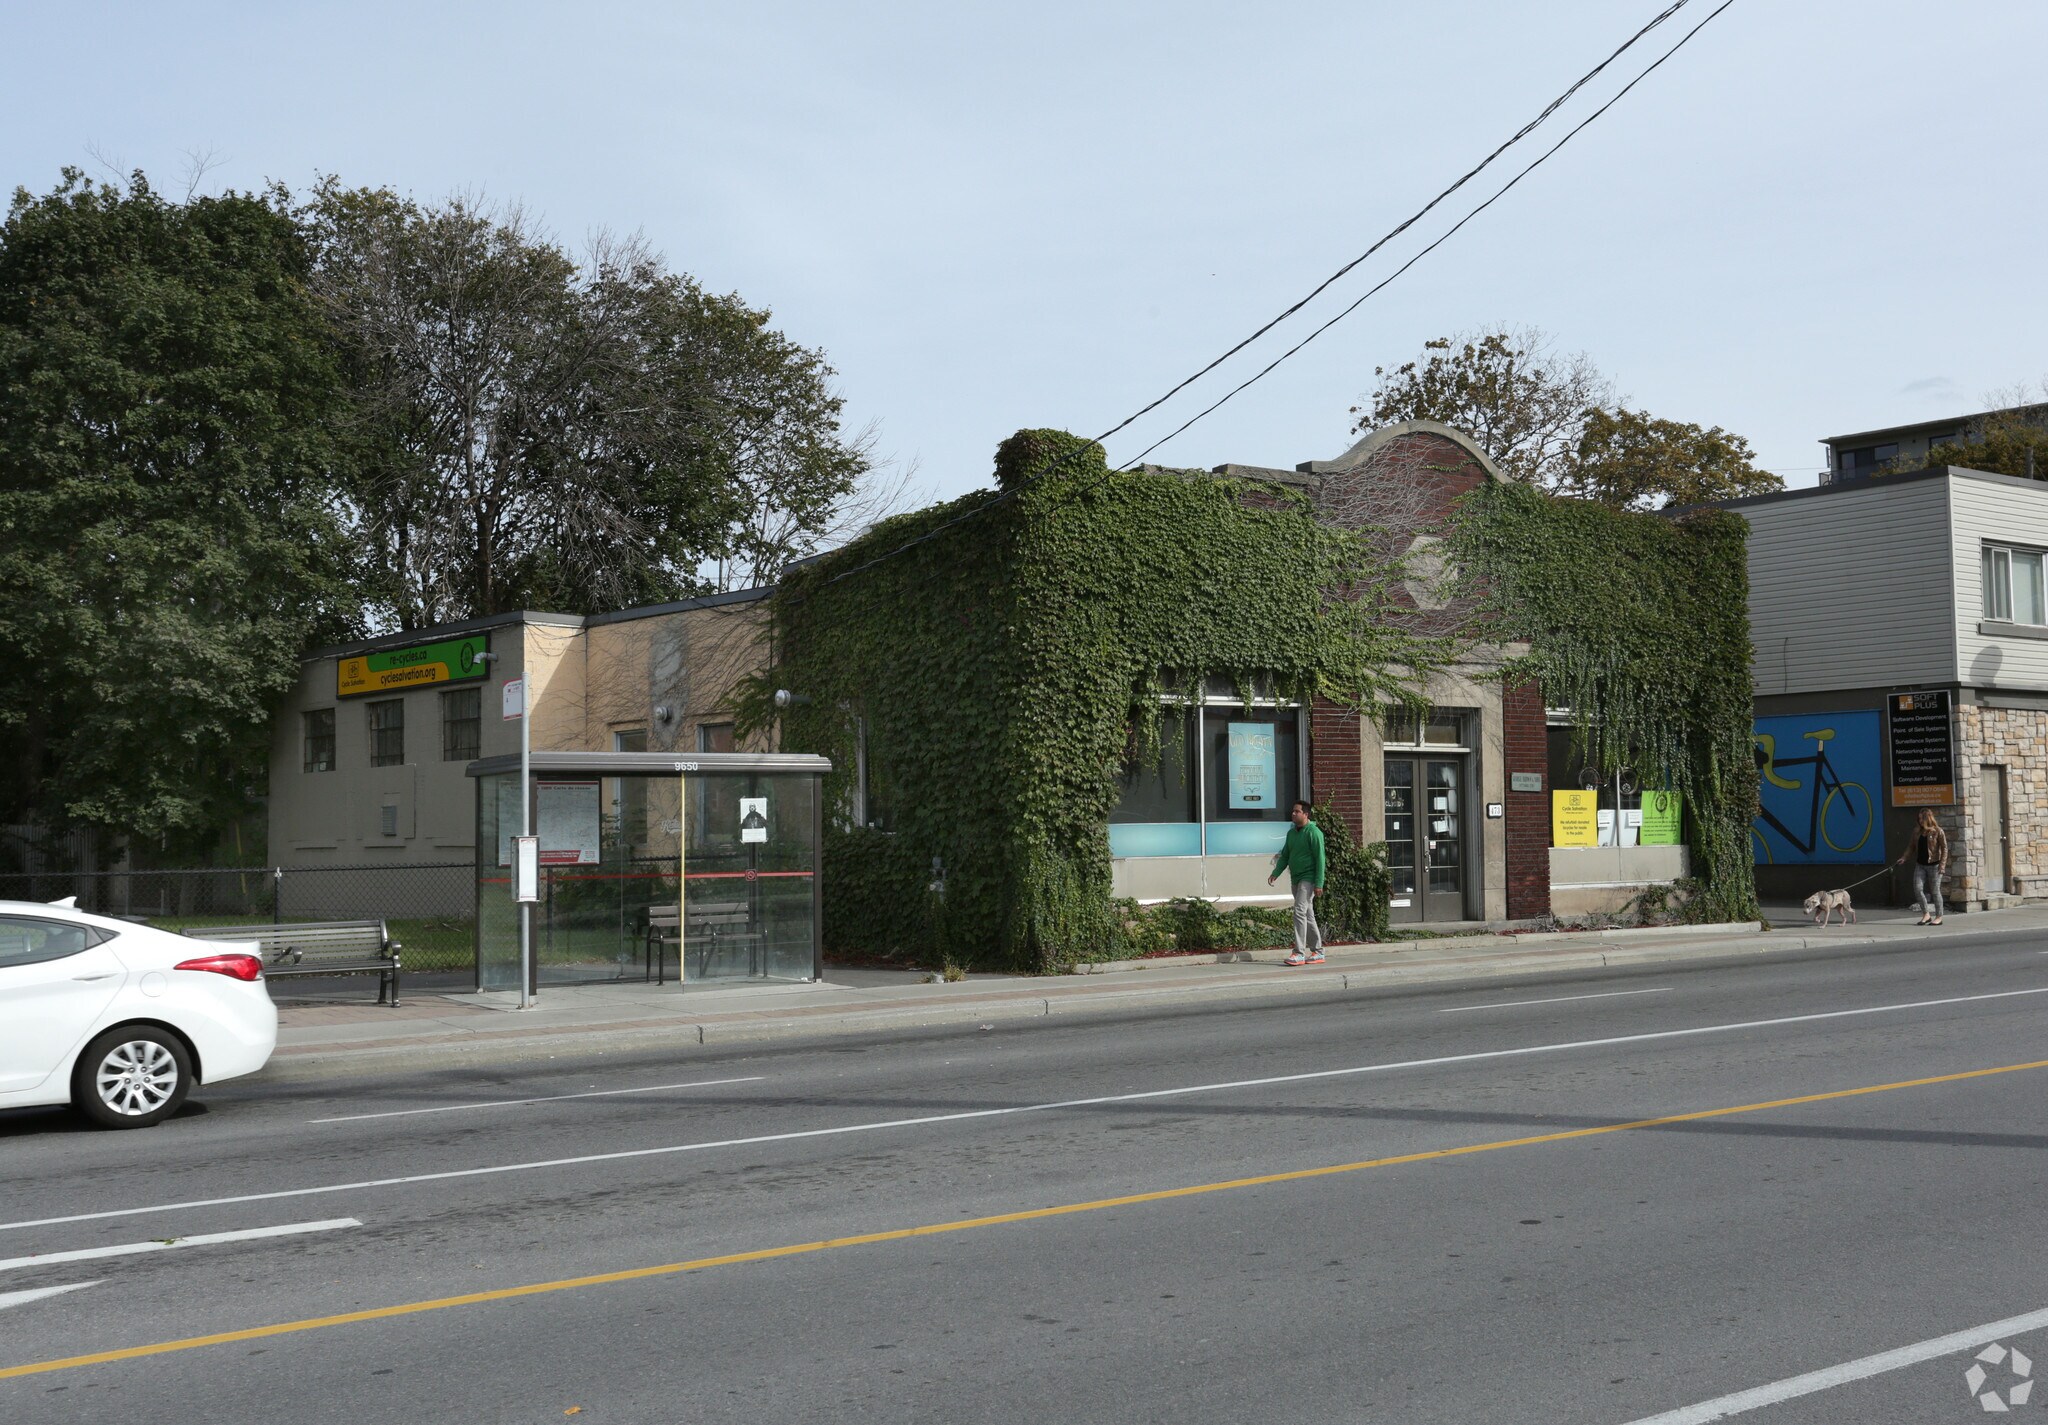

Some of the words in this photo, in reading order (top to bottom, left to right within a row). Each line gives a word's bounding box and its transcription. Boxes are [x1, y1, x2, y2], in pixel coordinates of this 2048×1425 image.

[380, 667, 436, 686] cyclesalvation.org
[1913, 693, 1938, 701] SOFT
[1914, 701, 1938, 710] PLUS
[1915, 714, 1947, 722] Development
[1925, 725, 1946, 733] Systems
[674, 761, 699, 771] 9650
